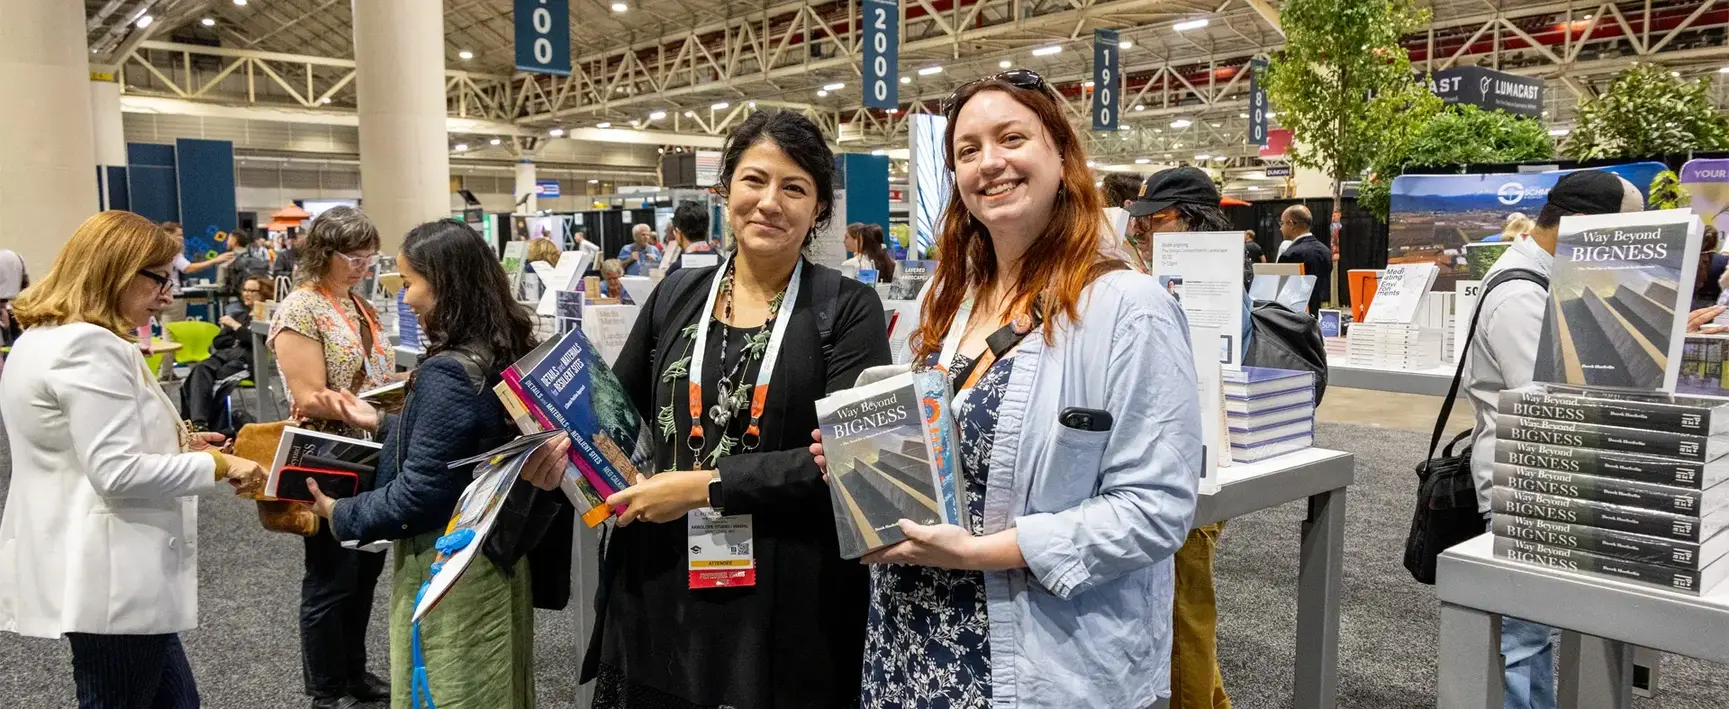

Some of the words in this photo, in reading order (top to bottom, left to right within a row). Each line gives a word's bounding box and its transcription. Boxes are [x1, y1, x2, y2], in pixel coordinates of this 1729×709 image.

[533, 0, 552, 64] 00
[874, 8, 887, 101] 2000
[1101, 49, 1110, 125] 1900
[1495, 79, 1539, 100] LUMACAST
[1695, 170, 1726, 178] YOUR
[1583, 231, 1610, 245] Way
[1614, 228, 1661, 244] Beyond
[1571, 243, 1668, 262] BIGNESS
[1321, 321, 1336, 329] 50%
[541, 365, 560, 387] DETAILS
[560, 342, 582, 366] MATERIALS
[553, 367, 575, 392] RESILIENT
[570, 358, 584, 374] SITES
[836, 407, 858, 420] Way
[861, 393, 897, 413] Beyond
[1522, 392, 1541, 403] Way
[1543, 395, 1578, 406] Beyond
[1513, 402, 1585, 420] BIGNESS
[525, 380, 544, 399] DETAILS
[546, 403, 569, 428] MATERIALS
[570, 430, 593, 454] RESILIENT
[588, 450, 603, 465] SITES
[833, 405, 907, 440] BIGNESS
[1520, 418, 1538, 430] Way
[1541, 421, 1576, 432] Beyond
[1511, 428, 1583, 446] BIGNESS
[1517, 443, 1537, 454] Way
[1539, 445, 1573, 457] Beyond
[1508, 452, 1580, 471] BIGNESS
[1516, 467, 1536, 478] Way
[1538, 470, 1572, 482] Beyond
[1508, 476, 1579, 497] BIGNESS
[1514, 492, 1533, 503] Way
[1536, 495, 1570, 507] Beyond
[1506, 501, 1577, 521] BIGNESS
[1515, 516, 1534, 527] Way
[1537, 520, 1571, 532] Beyond
[1507, 525, 1578, 547] BIGNESS
[1515, 540, 1534, 552] Way
[1537, 544, 1571, 557] Beyond
[1507, 550, 1579, 571] BIGNESS
